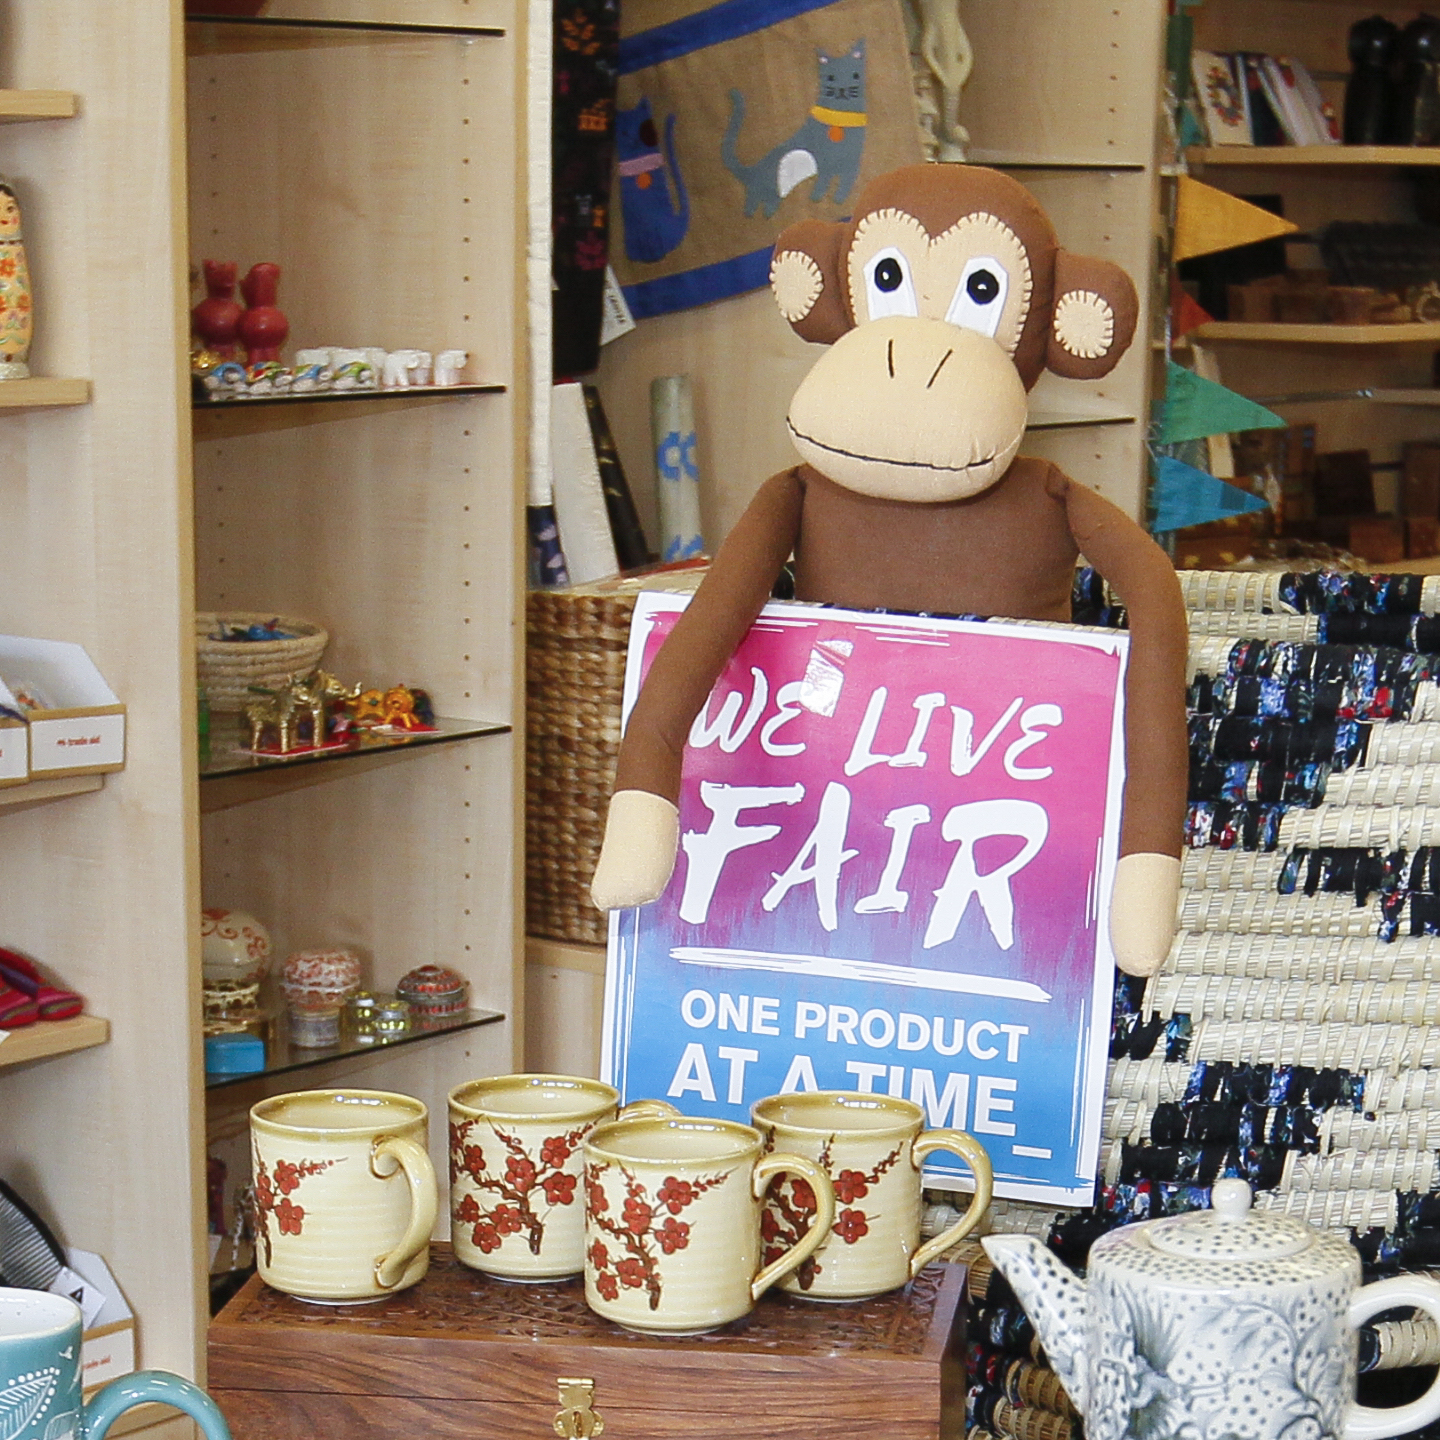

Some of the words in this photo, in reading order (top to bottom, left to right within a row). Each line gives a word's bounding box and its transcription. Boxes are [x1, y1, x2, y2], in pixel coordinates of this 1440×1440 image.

[688, 667, 812, 758] WE
[843, 686, 1064, 781] LIVE
[678, 781, 1050, 951] FAIR
[680, 988, 780, 1036] ONE
[794, 1000, 1030, 1064] PRODUCT
[666, 1042, 759, 1105] AT
[779, 1054, 821, 1094] A
[845, 1060, 1018, 1137] TIME
